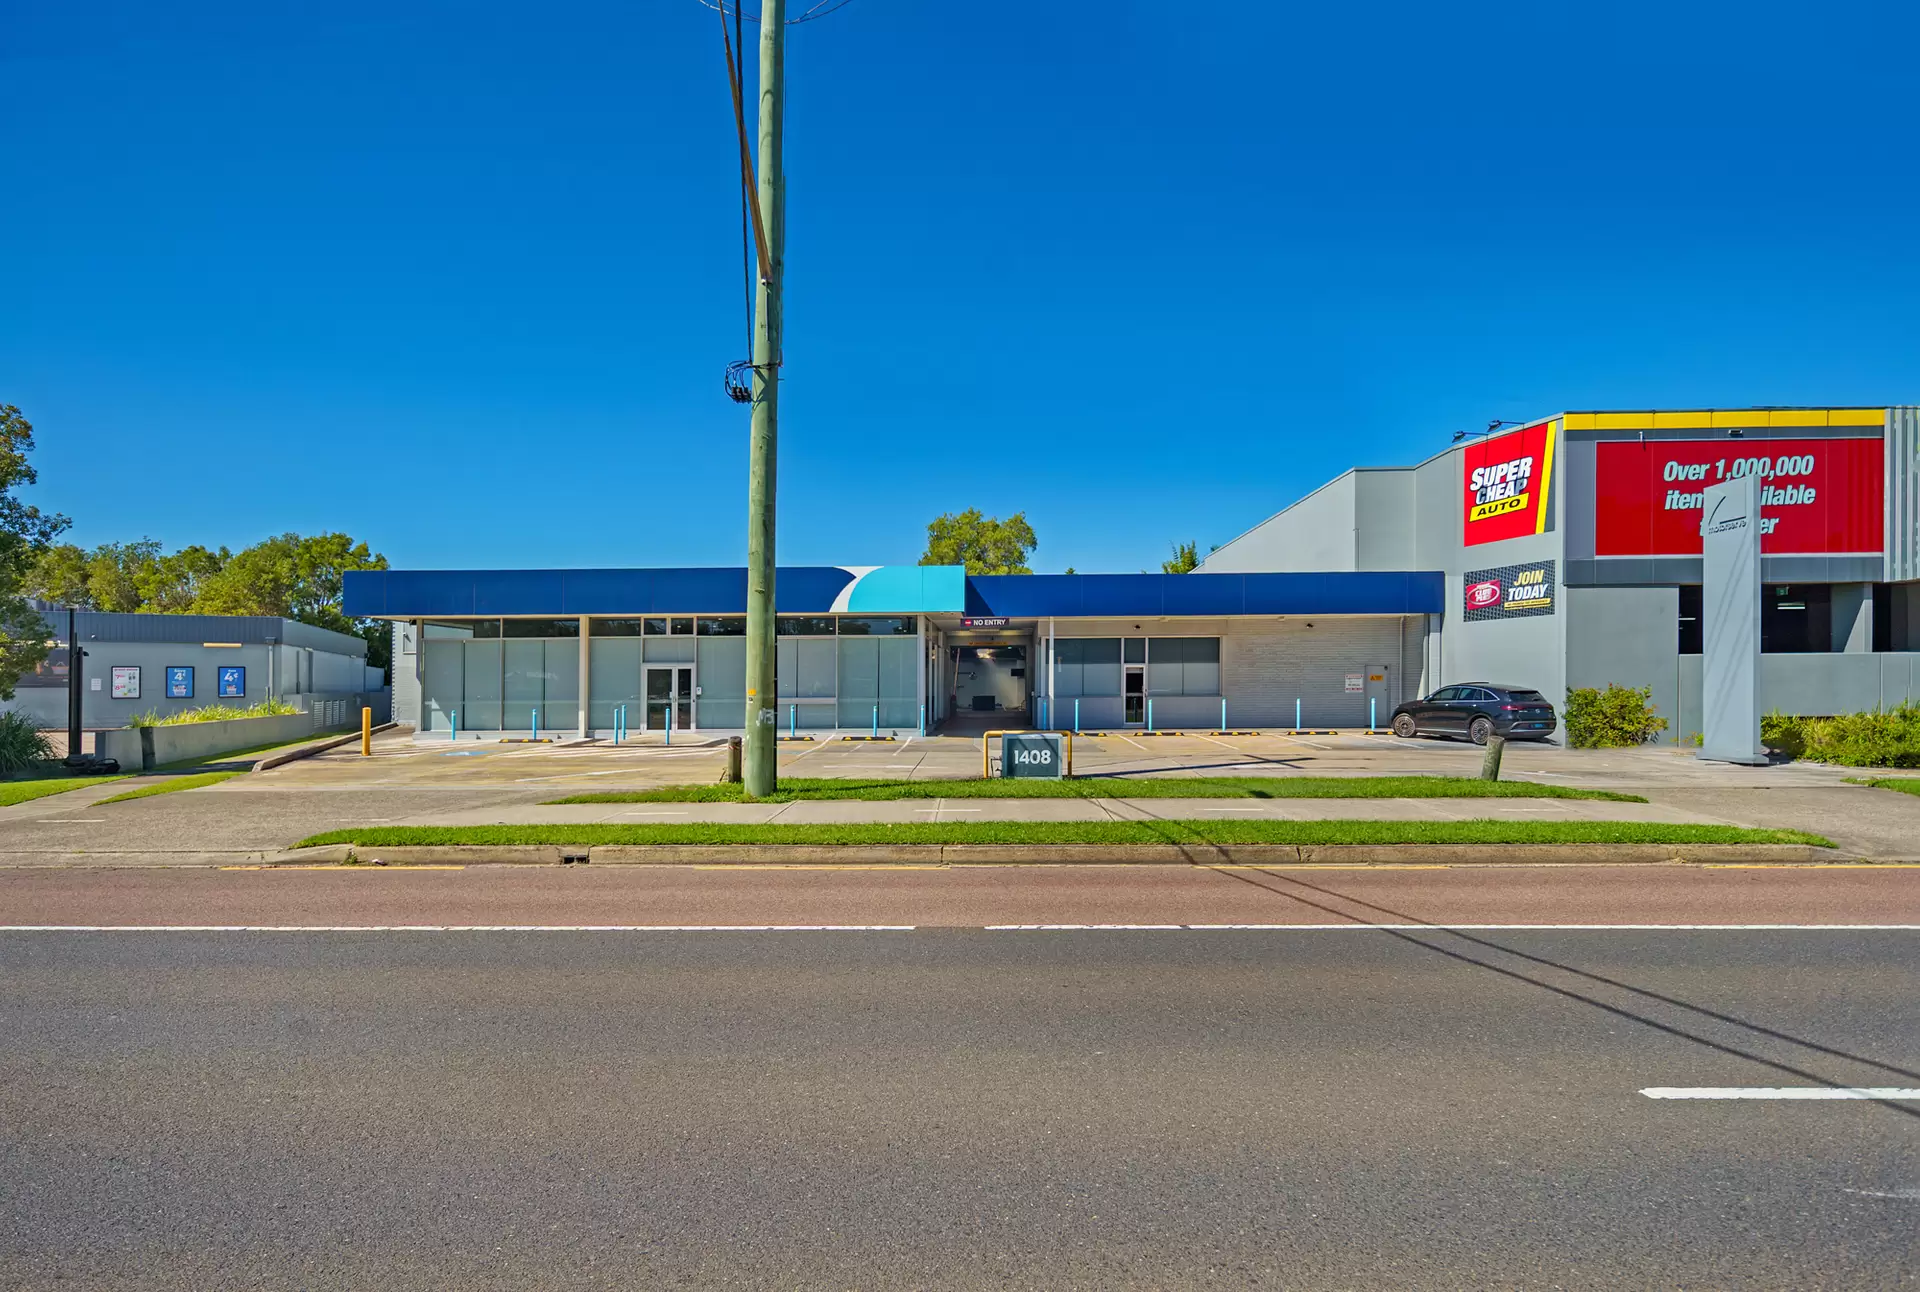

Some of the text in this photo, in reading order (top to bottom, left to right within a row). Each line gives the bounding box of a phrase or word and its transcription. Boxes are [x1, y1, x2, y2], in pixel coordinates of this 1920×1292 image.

[1470, 456, 1533, 491] SUPER
[1663, 455, 1815, 482] Over 1,000,000
[1475, 478, 1528, 505] CHEAP
[1664, 490, 1704, 510] item
[1477, 499, 1521, 517] AUTO
[1514, 569, 1545, 586] JOIN
[1508, 584, 1549, 600] TODAY
[1014, 749, 1051, 765] 1408
